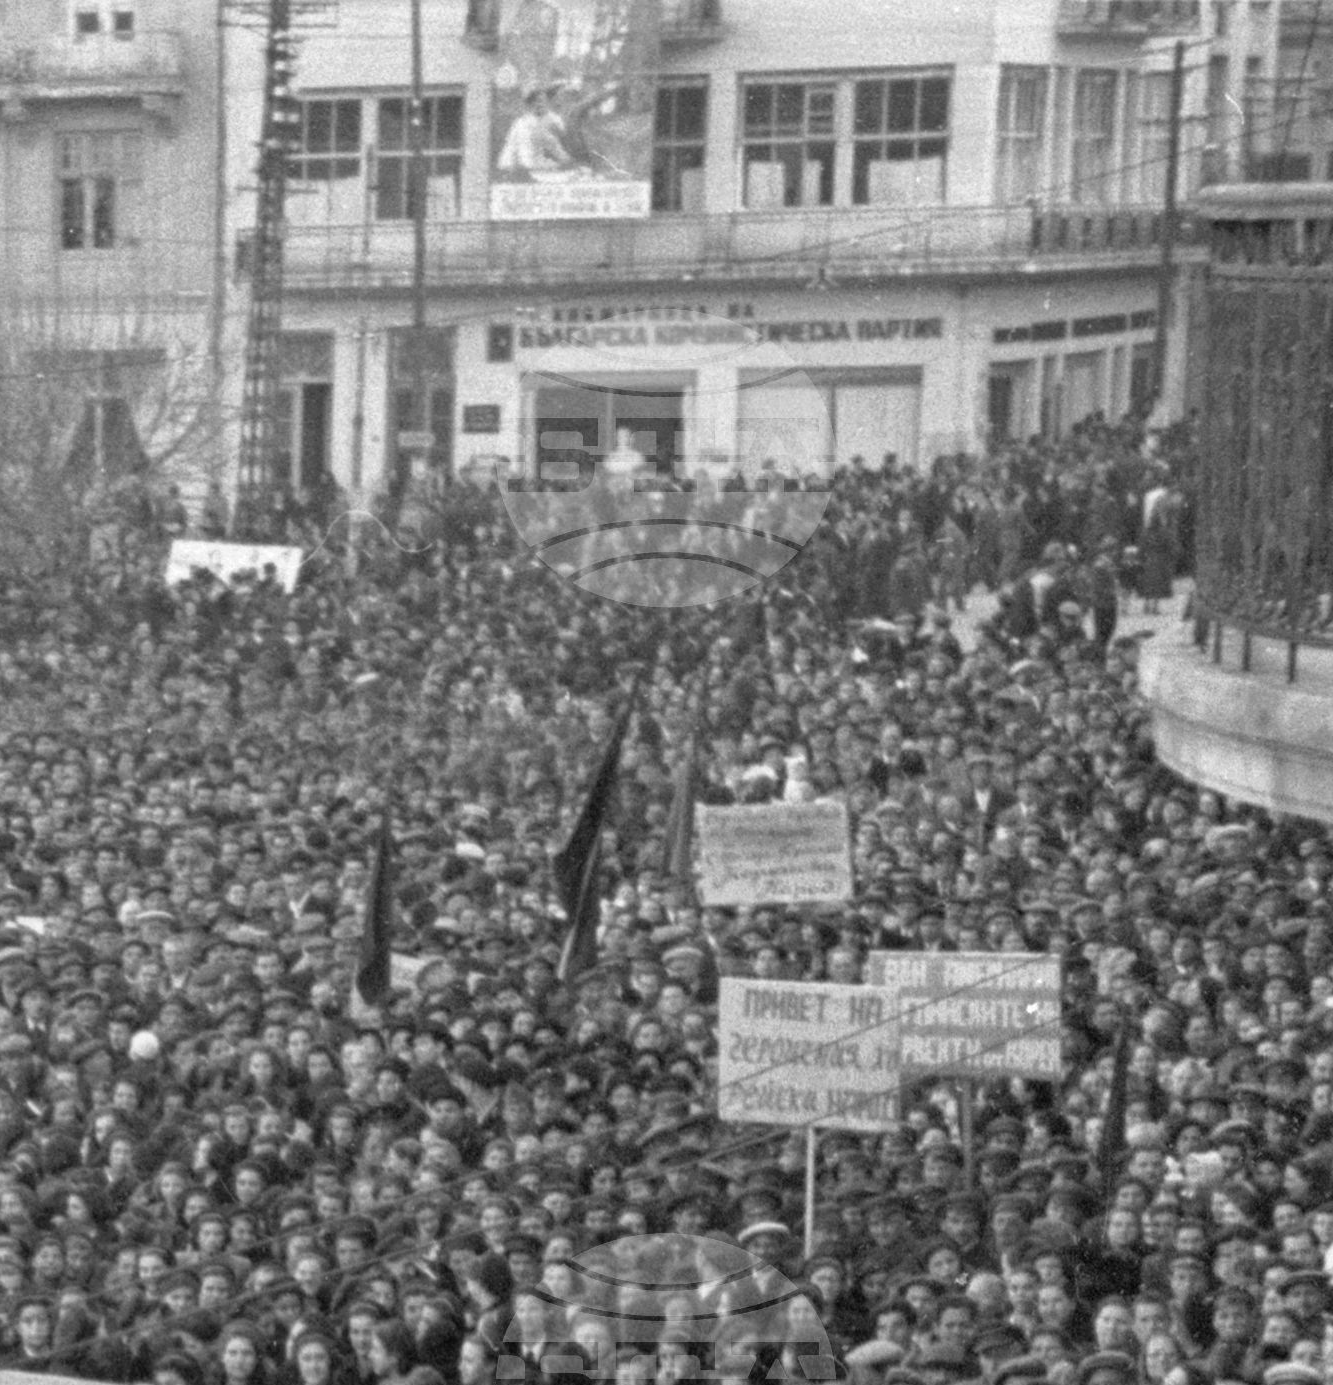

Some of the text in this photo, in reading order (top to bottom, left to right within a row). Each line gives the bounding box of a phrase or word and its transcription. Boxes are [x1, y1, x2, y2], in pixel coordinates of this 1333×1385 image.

[856, 315, 943, 342] ПАРТИЯ
[742, 988, 830, 1023] ПРИВЕТ
[848, 994, 884, 1025] НА
